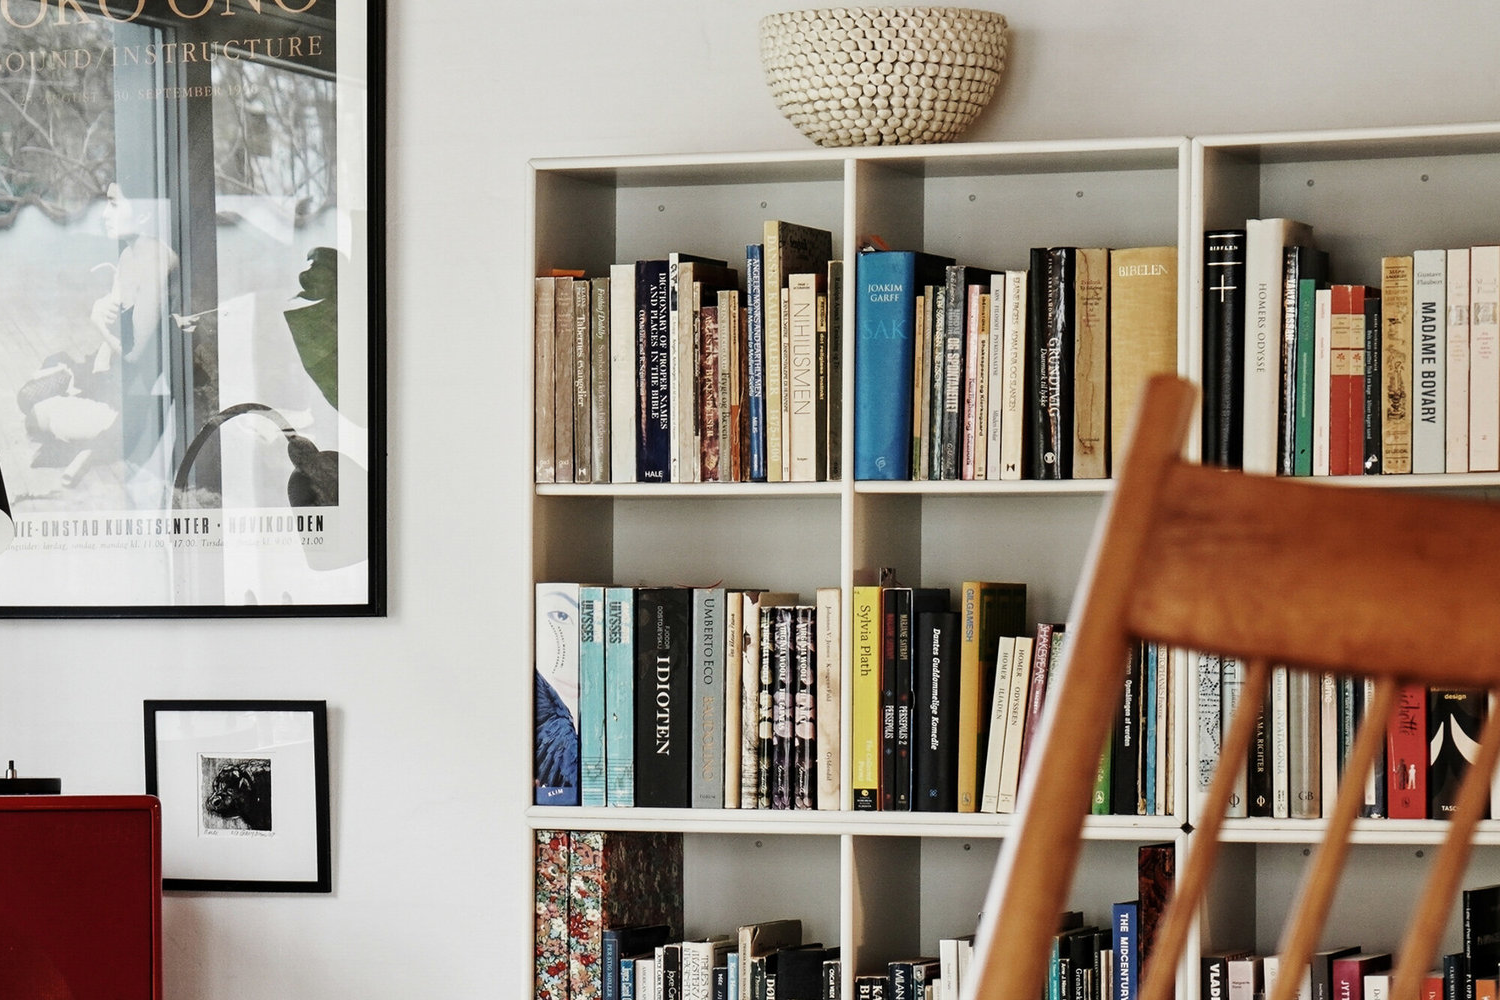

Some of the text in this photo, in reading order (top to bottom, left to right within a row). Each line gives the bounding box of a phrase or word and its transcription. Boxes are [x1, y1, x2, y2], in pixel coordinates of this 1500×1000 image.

[139, 87, 221, 99] SEPTEMBER
[1118, 265, 1168, 276] BIBELEN
[596, 288, 605, 339] Frithiof Dahlby
[1257, 283, 1267, 373] HOMERS ODYSSE
[1286, 279, 1296, 341] YAHYA HASSAN
[651, 351, 658, 362] IN
[660, 335, 667, 348] OF
[767, 235, 779, 461] DANSKE KALKMALERIER 1475-1500
[793, 303, 811, 415] NIHILISMEN
[948, 338, 959, 350] OG
[576, 315, 585, 407] Tabernes evangelier
[1010, 366, 1017, 378] OG
[1048, 337, 1060, 417] GRUNDTVIG
[1422, 302, 1436, 424] MADAME BOVARY
[719, 373, 729, 390] Frygt
[946, 353, 959, 413] SPONTANEITET
[1008, 380, 1017, 412] SLANGEN
[1039, 390, 1048, 407] lykke
[719, 392, 728, 408] og
[581, 600, 594, 642] ULYSSES
[609, 601, 622, 644] ULYSSES
[900, 614, 908, 637] MARJANE
[965, 588, 974, 642] GILGAMESH
[857, 605, 871, 676] Sylvia Plath
[1035, 625, 1050, 684] SHAKESPEARE
[702, 598, 714, 781] UMBERTO ECO BAUDOLINO
[930, 657, 940, 715] Guddommelige
[996, 652, 1009, 719] HOMER ILIADEN
[1011, 649, 1025, 726] HOMER ODYSSEEN
[1124, 680, 1132, 716] Opmålingen
[656, 656, 670, 756] IDIOTEN
[885, 705, 894, 739] PERSEPOLIS
[898, 706, 908, 739] PERSEPOLIS
[930, 716, 939, 750] Komedie
[1120, 913, 1129, 932] THE
[621, 966, 632, 982] Joyce
[622, 983, 632, 996] Carol
[667, 970, 676, 986] Joyce
[896, 969, 904, 1000] MILAN
